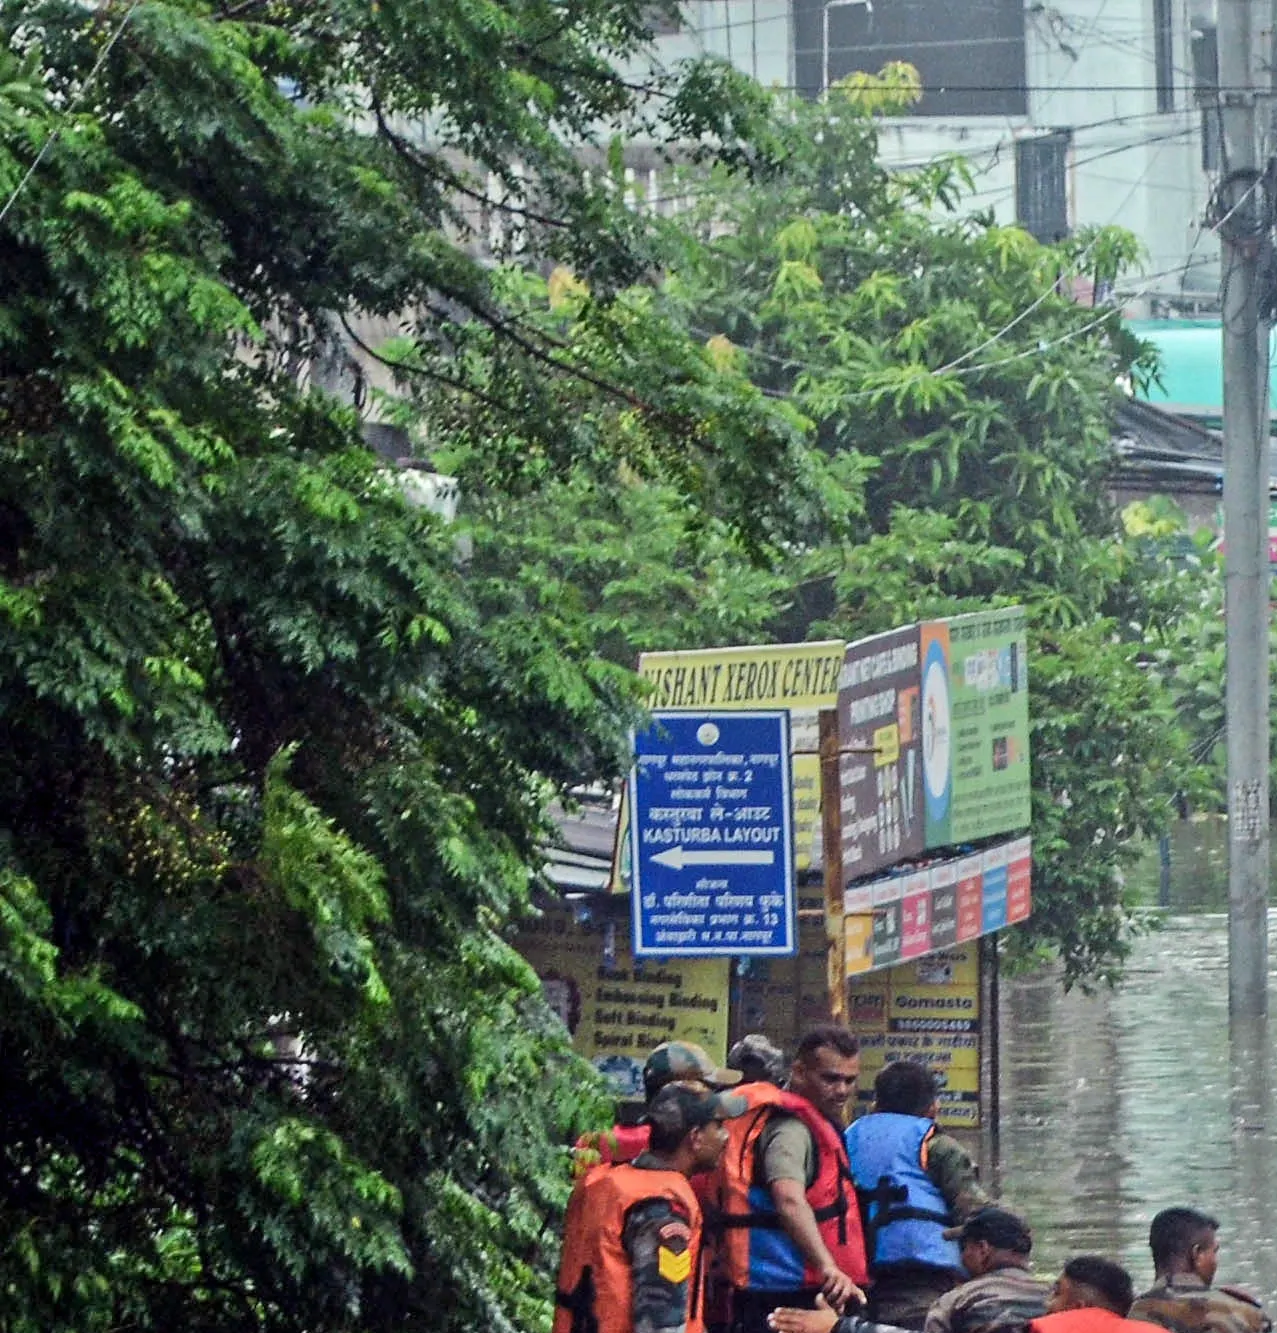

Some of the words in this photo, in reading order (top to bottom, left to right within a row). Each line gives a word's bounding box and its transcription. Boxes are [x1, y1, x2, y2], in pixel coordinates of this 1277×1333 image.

[723, 660, 780, 702] XEROX
[782, 656, 840, 697] CENTER
[643, 828, 721, 843] KASTURBA
[724, 828, 780, 843] LAYOUT
[669, 992, 718, 1012] Binding
[627, 1011, 676, 1031] Binding
